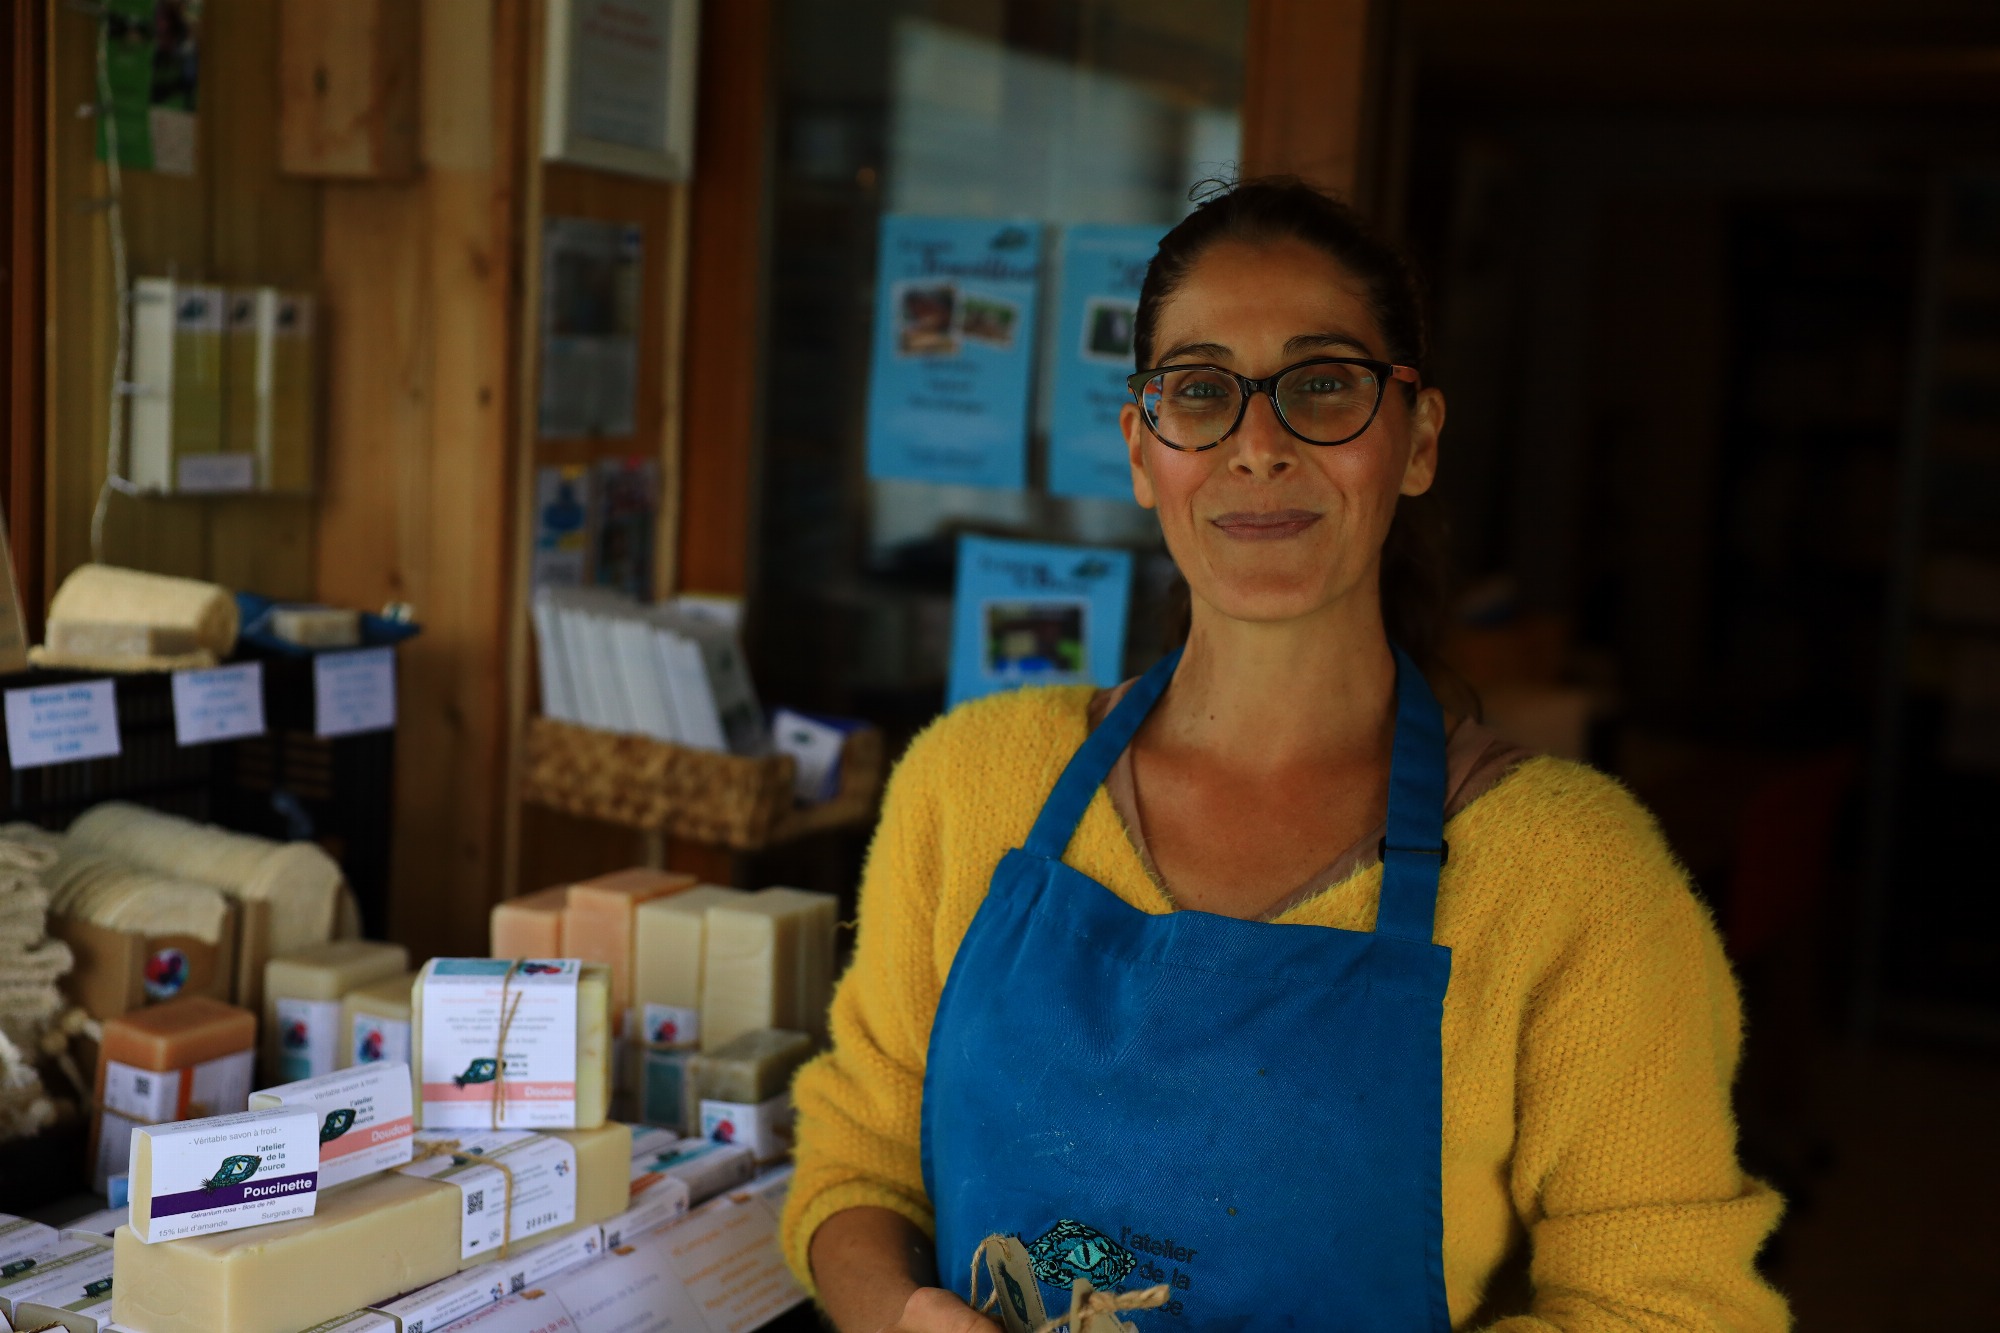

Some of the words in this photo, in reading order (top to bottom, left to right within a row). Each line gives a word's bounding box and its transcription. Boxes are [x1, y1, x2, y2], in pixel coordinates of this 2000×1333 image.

[193, 1134, 228, 1146] Véritable
[229, 1131, 252, 1142] savon
[253, 1128, 259, 1138] à
[260, 1126, 277, 1136] froid
[371, 1123, 411, 1142] Doudou
[256, 1142, 286, 1153] l'atelier
[266, 1152, 276, 1161] de
[278, 1152, 286, 1160] la
[258, 1163, 286, 1173] source
[243, 1178, 313, 1199] Poucinette
[190, 1209, 222, 1220] Géranium
[223, 1206, 237, 1215] rosa
[242, 1202, 256, 1211] Bois
[257, 1201, 265, 1209] de
[261, 1208, 291, 1221] Surgras
[292, 1206, 304, 1215] 8%
[159, 1228, 176, 1238] 15%
[177, 1225, 189, 1235] lait
[190, 1219, 228, 1232] d'amande
[1120, 1225, 1197, 1264] l'atelier
[1138, 1261, 1165, 1284] de
[1171, 1267, 1191, 1290] la
